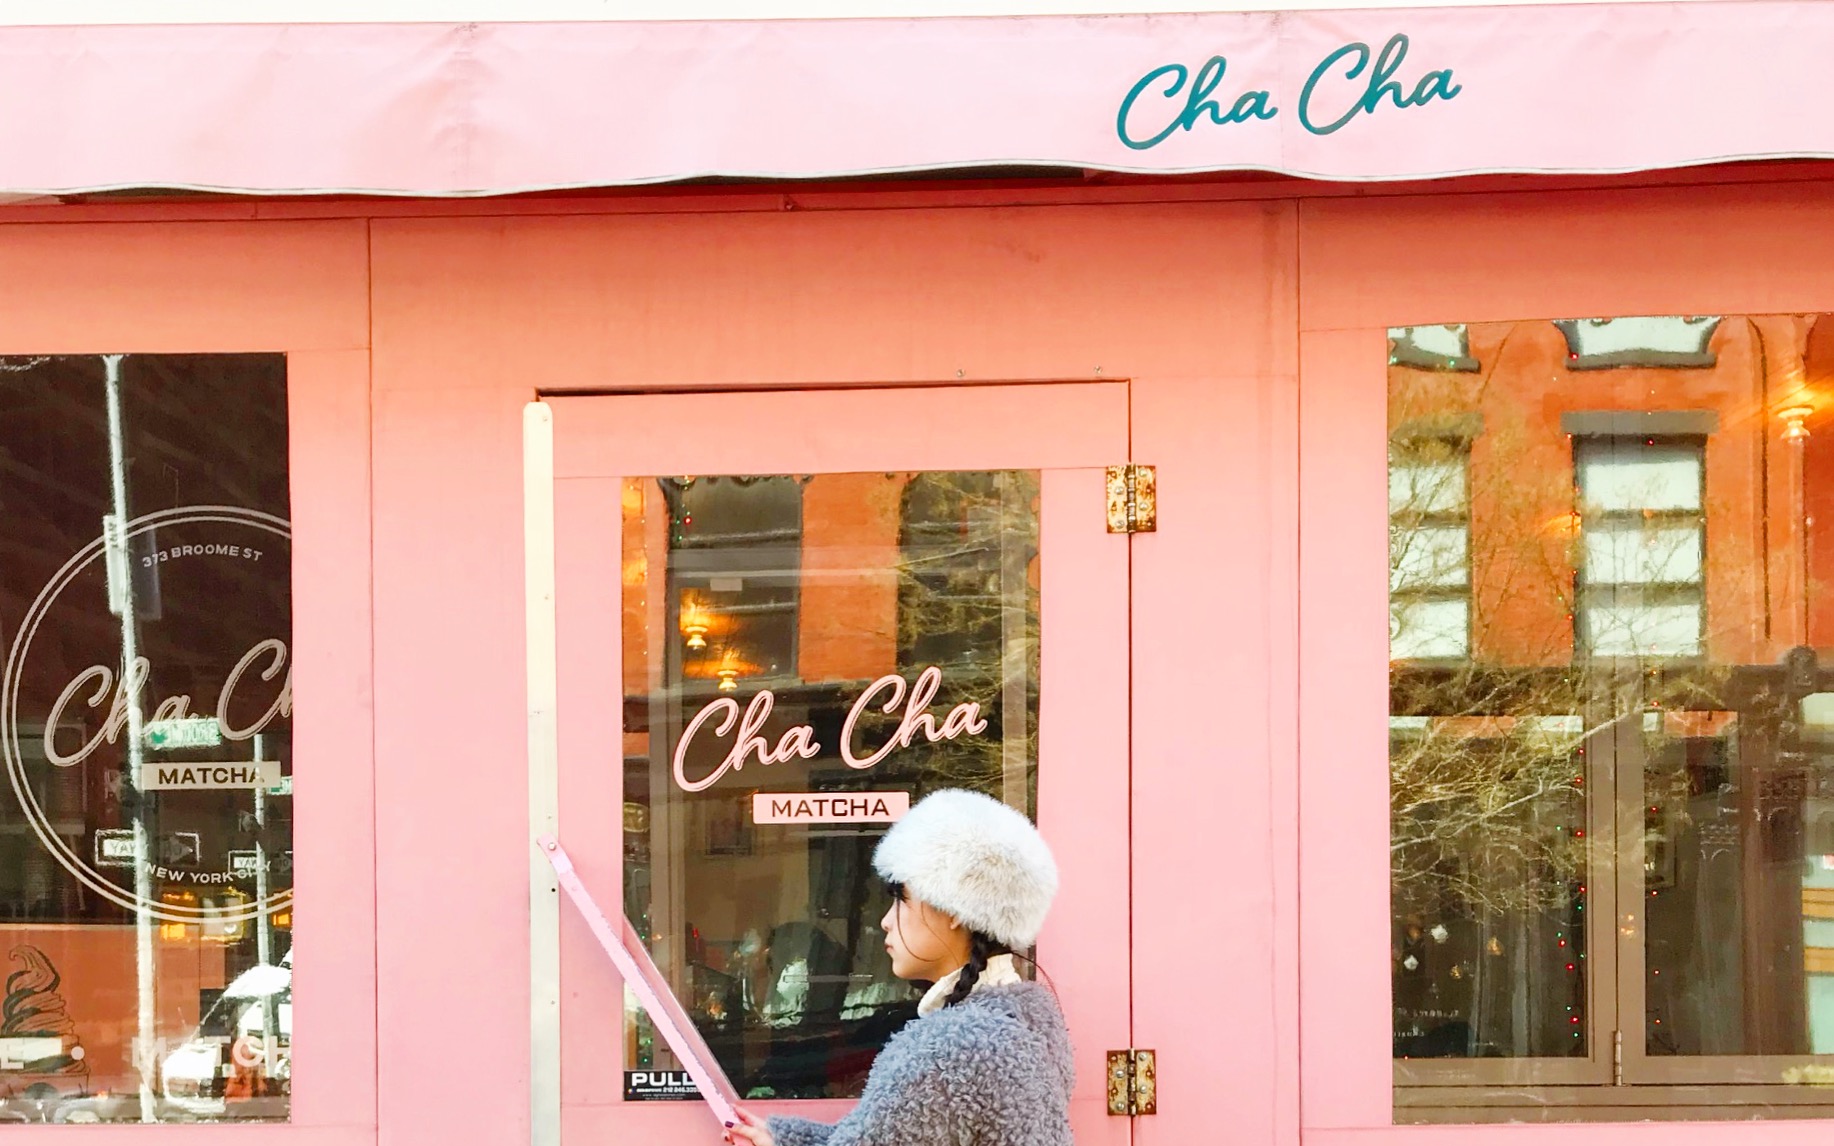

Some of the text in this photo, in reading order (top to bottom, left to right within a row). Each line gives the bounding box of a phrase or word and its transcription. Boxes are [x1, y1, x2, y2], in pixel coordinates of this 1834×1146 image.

[1117, 33, 1462, 150] Cha Cha
[142, 544, 263, 567] 373 BROOME ST
[44, 656, 199, 767] Cha
[673, 665, 988, 792] Cha Cha
[158, 767, 264, 784] MATCHA
[771, 798, 890, 817] MATCHA
[145, 864, 184, 881] NEW
[190, 872, 233, 884] YORK
[236, 860, 272, 879] CIY
[632, 1072, 696, 1087] PULL
